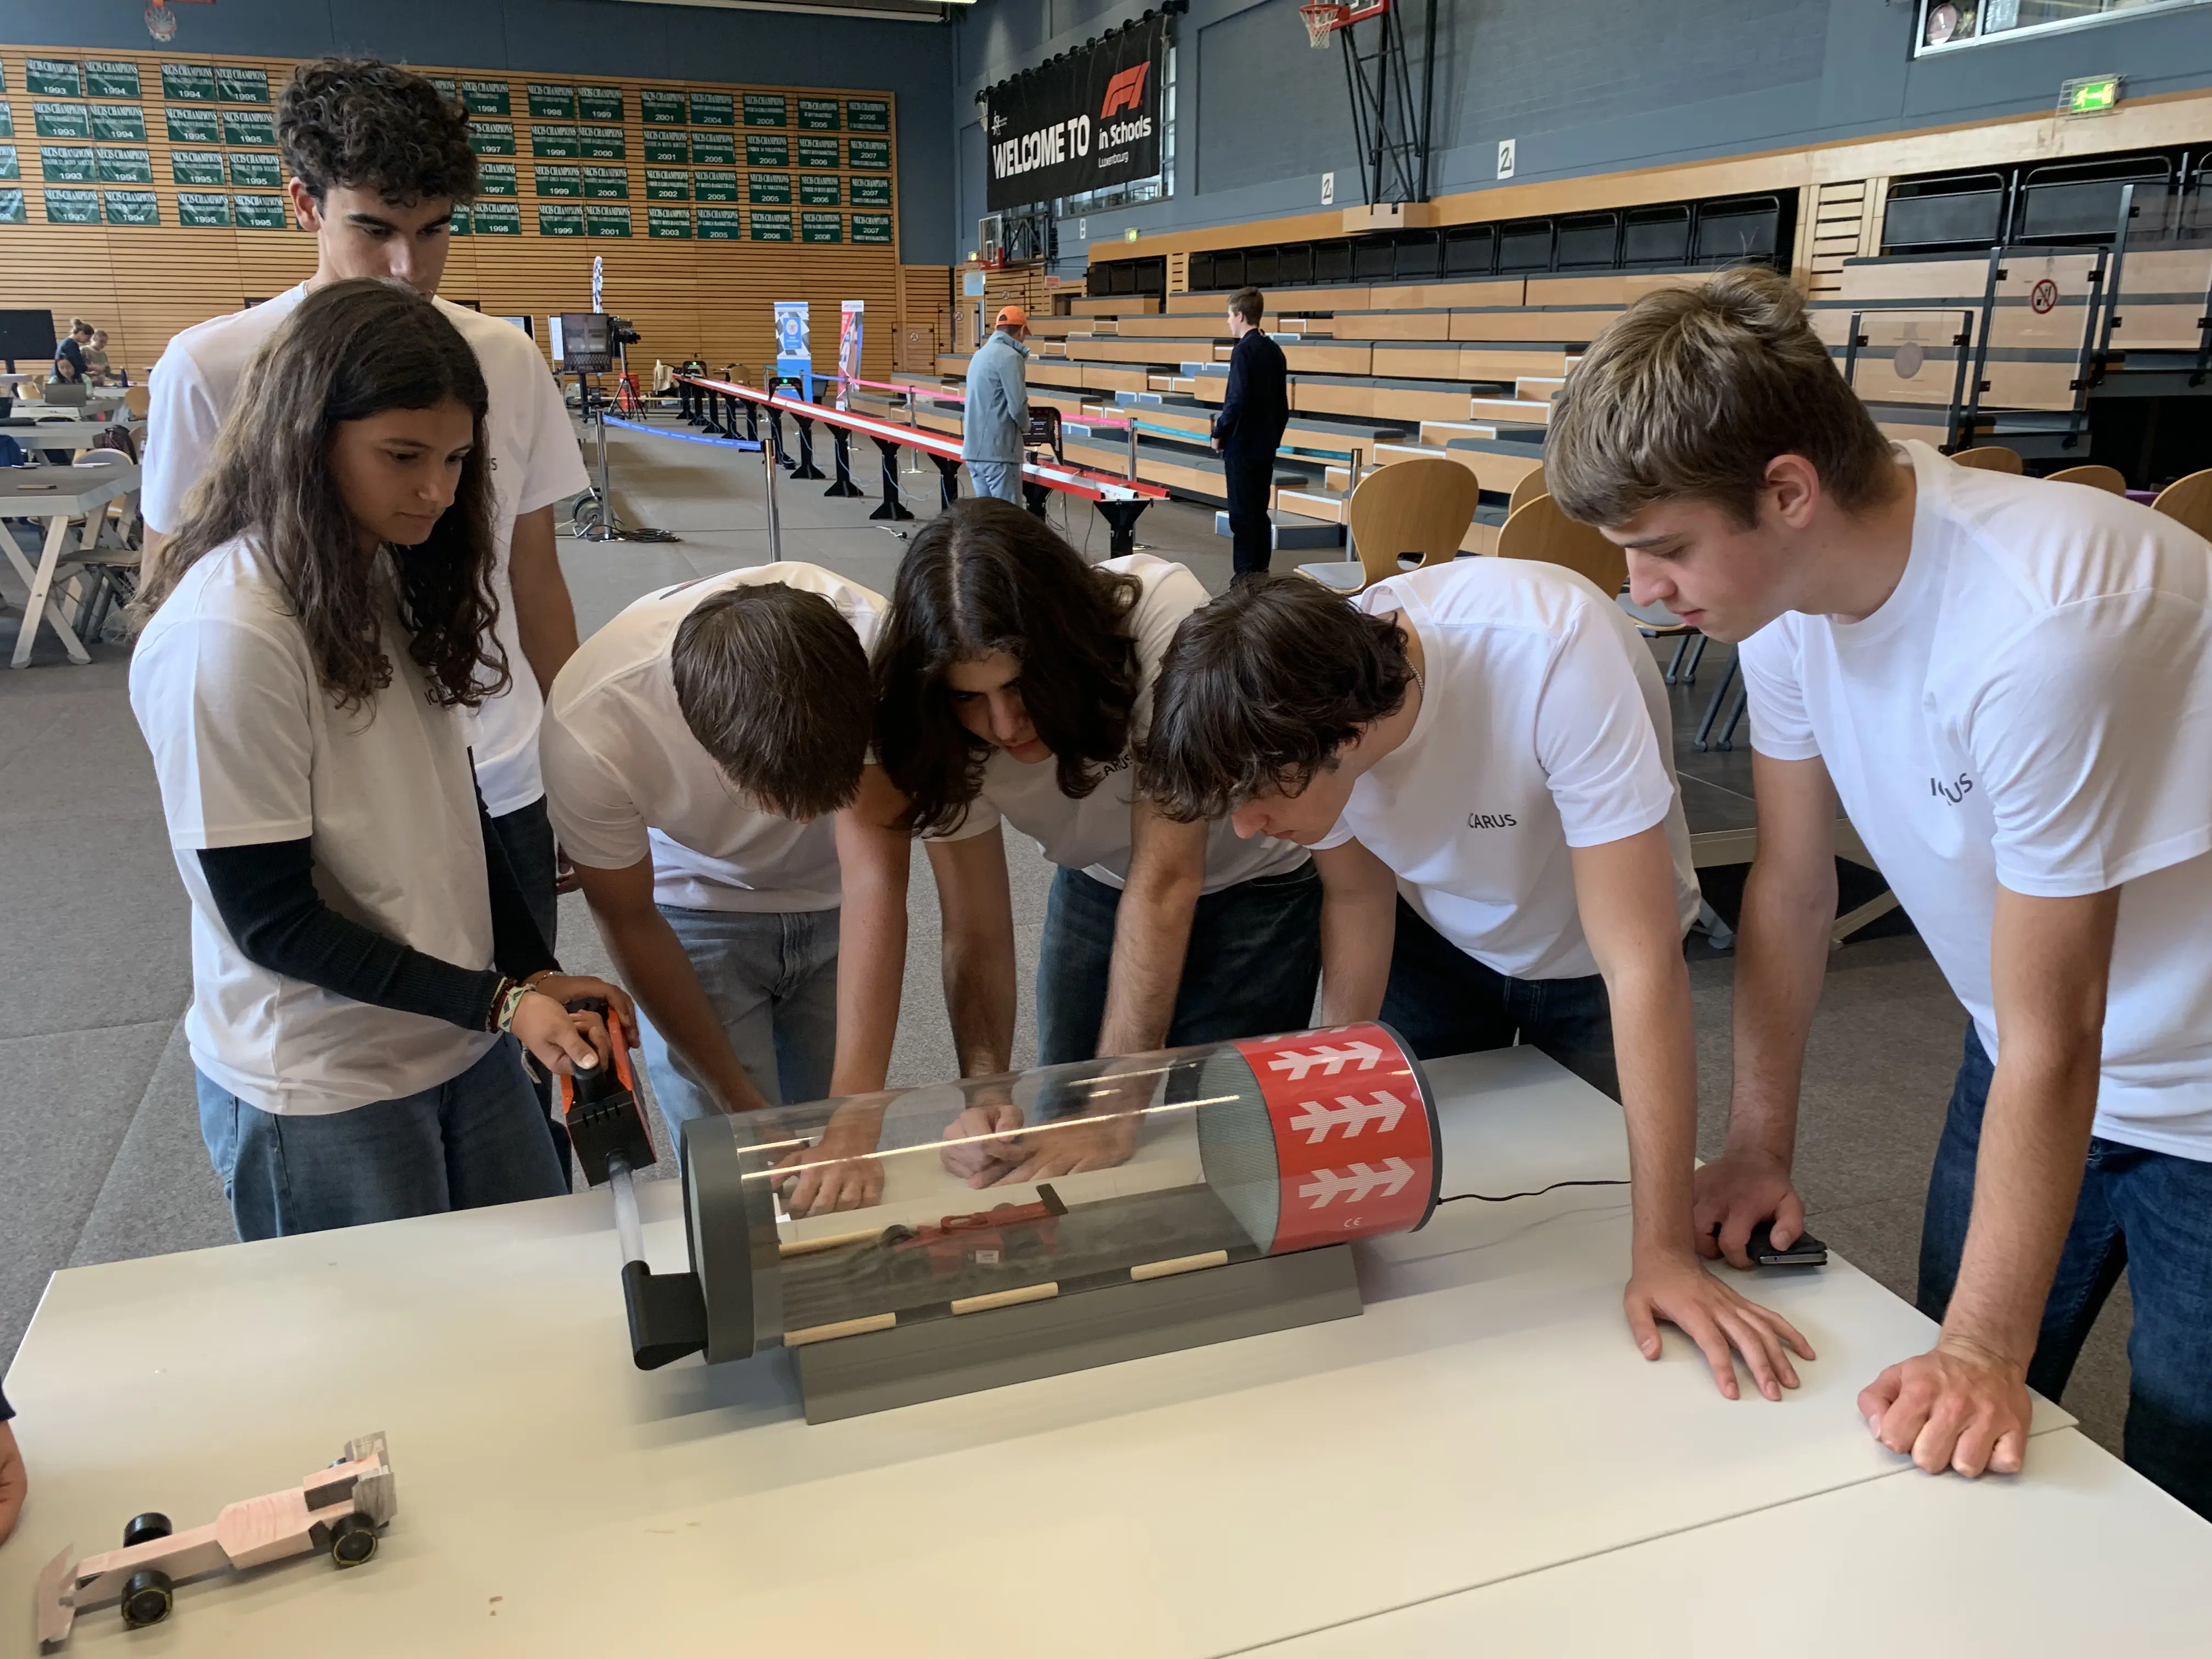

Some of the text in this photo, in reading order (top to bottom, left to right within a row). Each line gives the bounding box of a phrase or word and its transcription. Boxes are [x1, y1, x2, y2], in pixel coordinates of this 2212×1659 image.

[44, 86, 66, 94] 1993
[1098, 115, 1151, 150] in Schools
[993, 114, 1090, 179] WELCOME TO
[1098, 151, 1128, 168] Luxembourg
[1500, 147, 1512, 172] 2
[1323, 178, 1331, 199] 2
[1344, 1217, 1363, 1227] CE
